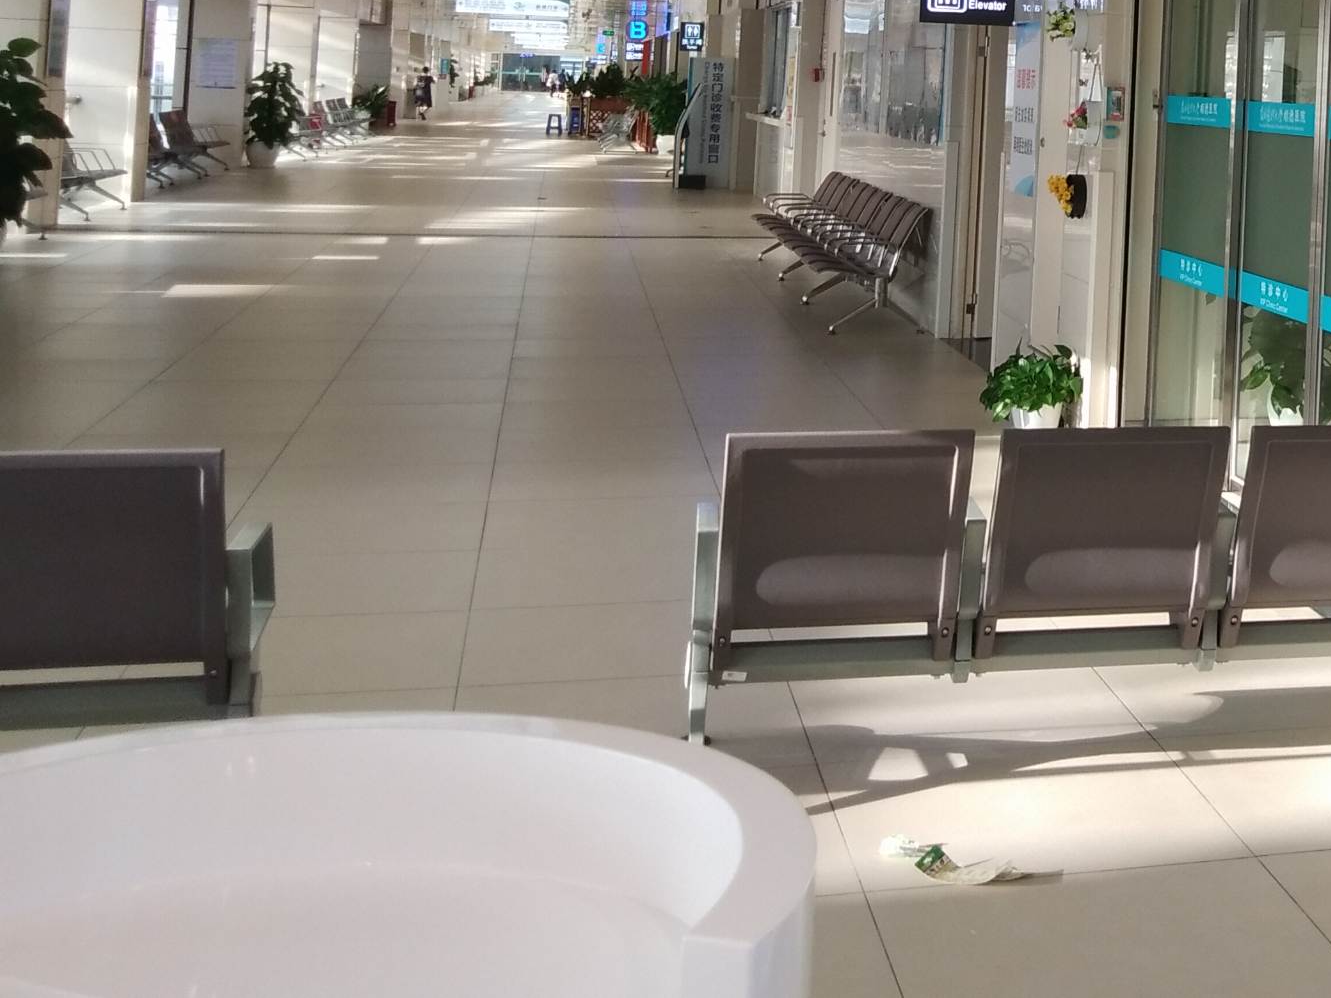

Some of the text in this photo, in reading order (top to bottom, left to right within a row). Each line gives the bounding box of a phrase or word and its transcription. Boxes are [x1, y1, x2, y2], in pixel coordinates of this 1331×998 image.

[629, 21, 647, 39] B
[708, 62, 724, 163] 特定门诊收费专用窗口
[1261, 281, 1288, 302] 特诊中心
